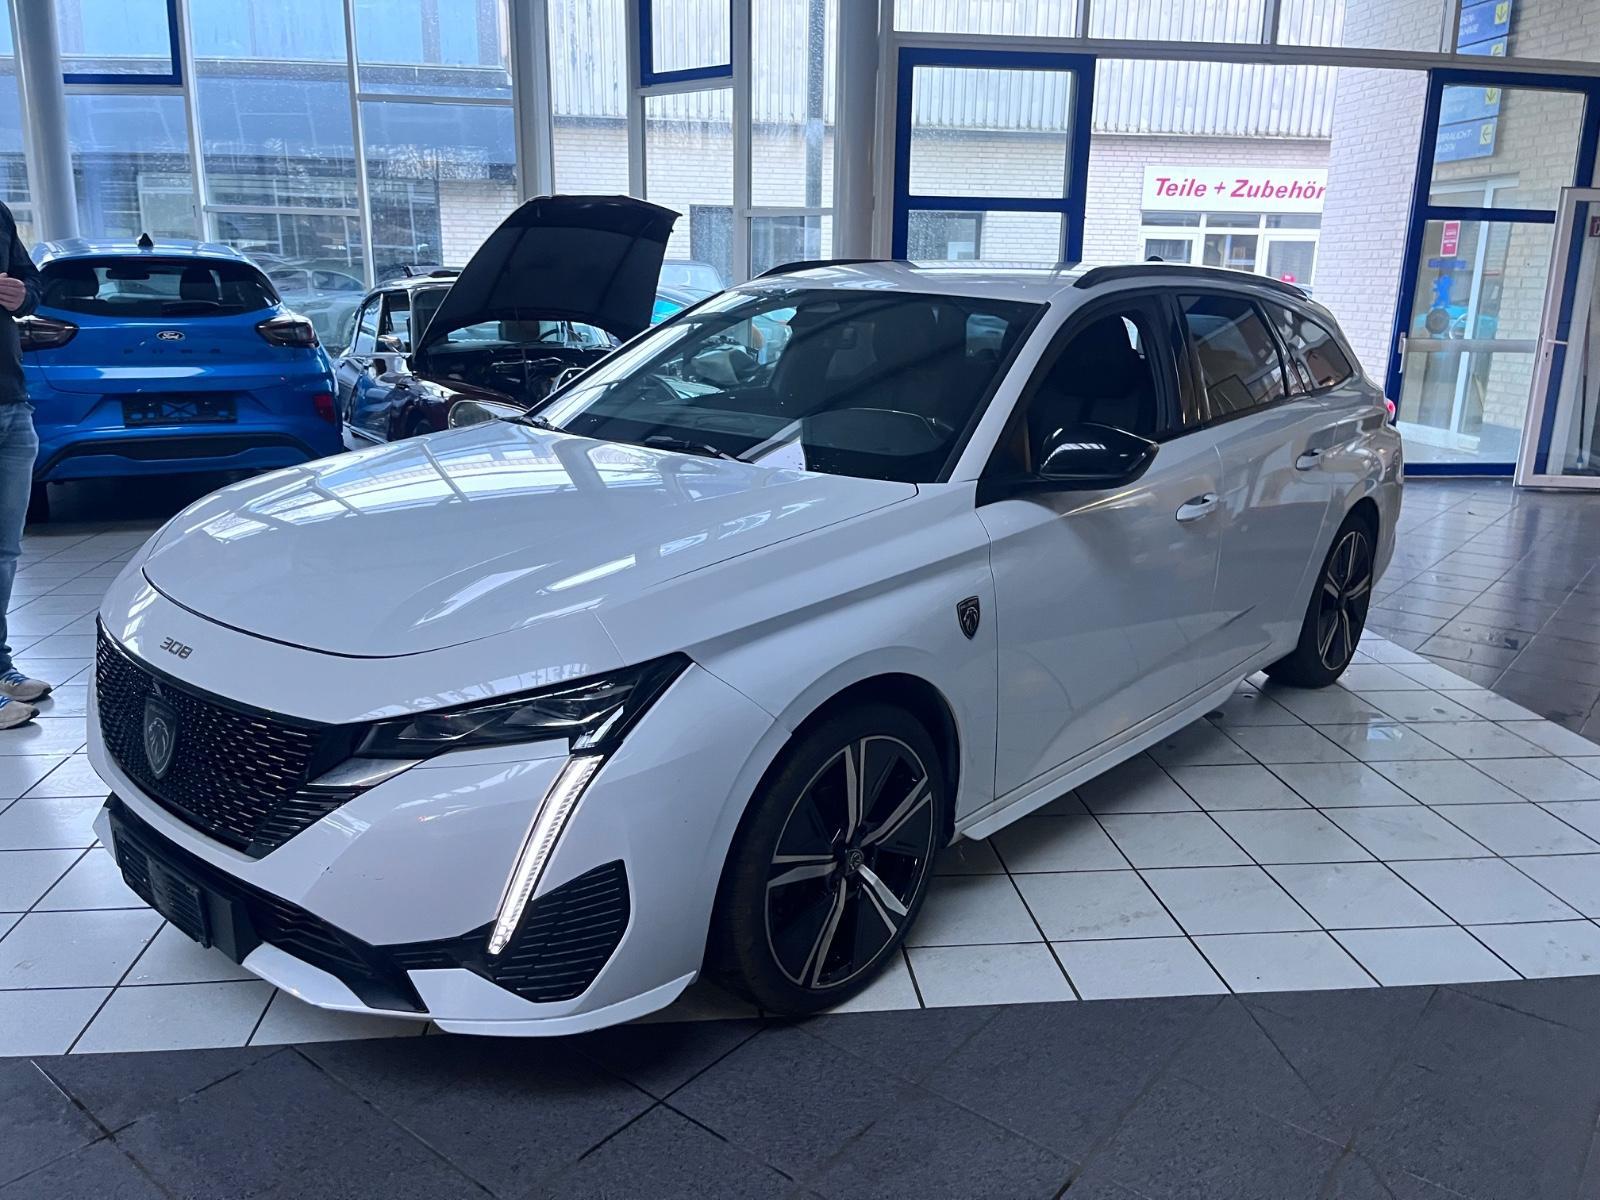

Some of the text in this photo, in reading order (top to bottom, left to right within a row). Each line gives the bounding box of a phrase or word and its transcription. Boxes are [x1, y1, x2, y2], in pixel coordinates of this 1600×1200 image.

[1155, 177, 1326, 199] Teile + Zubehör
[160, 636, 193, 660] 308
